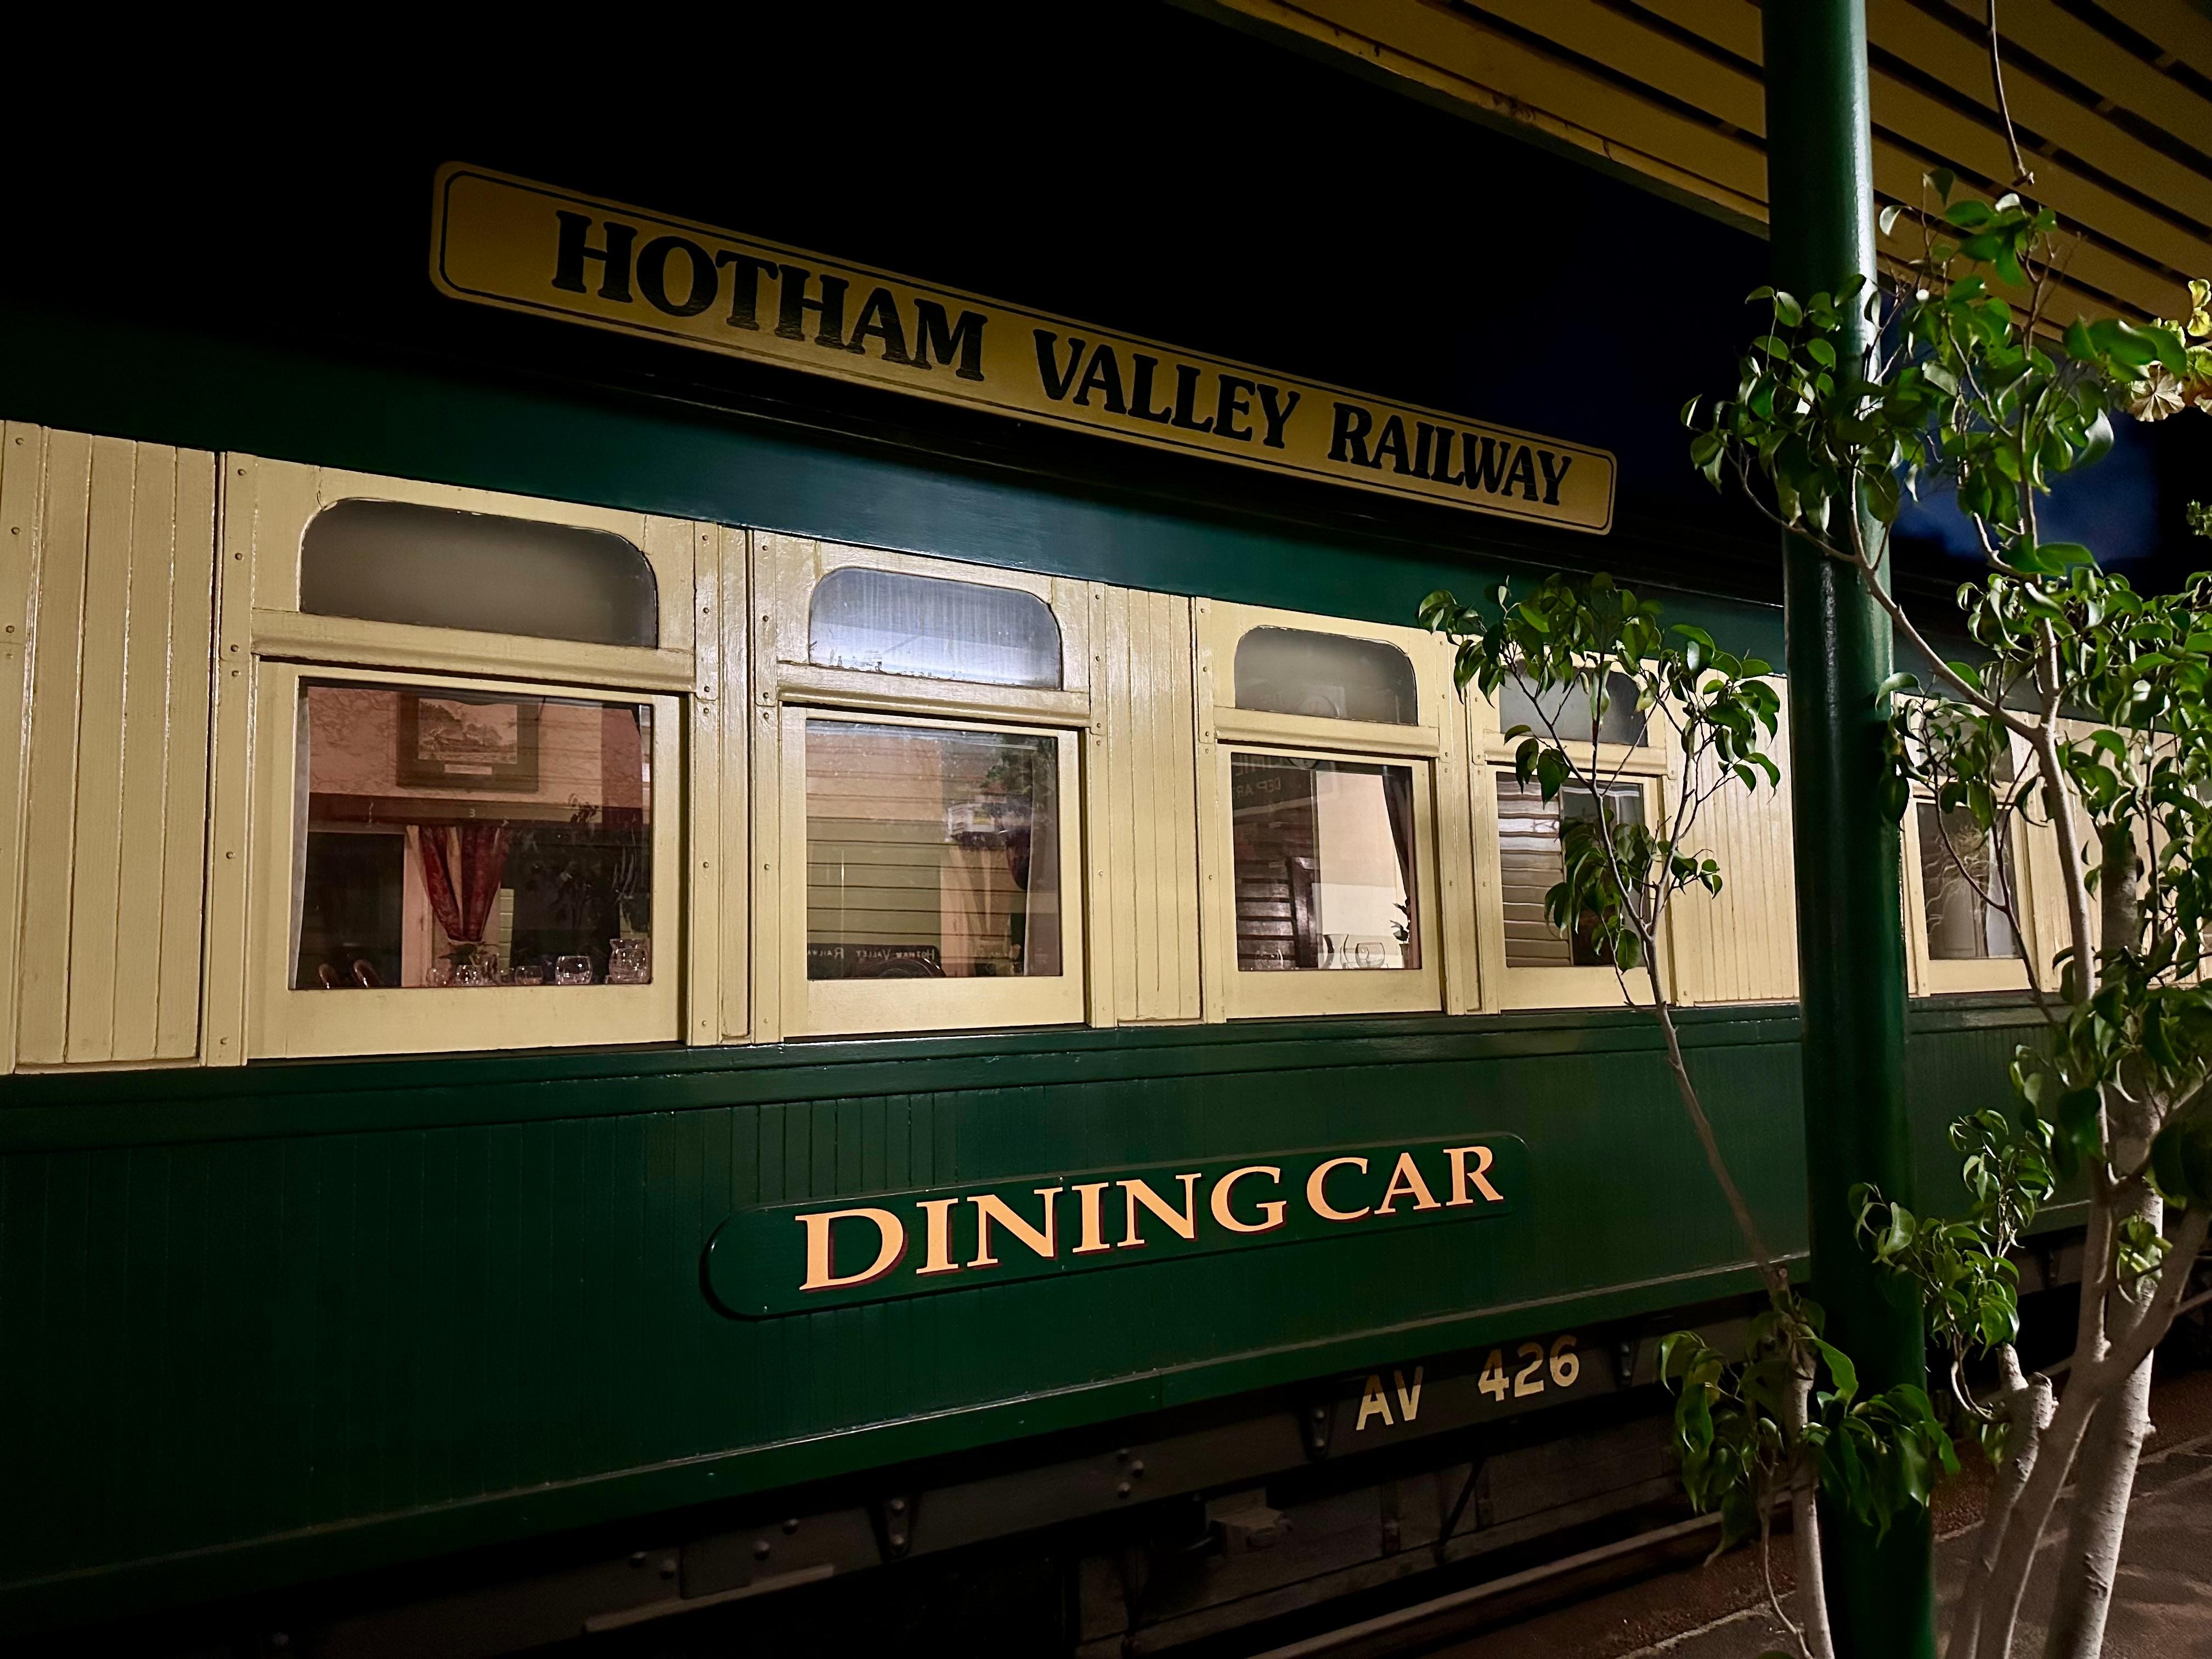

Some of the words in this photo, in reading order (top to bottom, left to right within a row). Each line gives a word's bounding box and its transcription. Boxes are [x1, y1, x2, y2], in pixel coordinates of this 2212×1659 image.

[551, 210, 988, 382] HOTHAM
[1032, 328, 1301, 449] VALLEY
[1328, 402, 1572, 506] RAILWAY
[795, 1166, 1287, 1292] DINING
[1306, 1146, 1504, 1222] CAR
[1356, 1366, 1423, 1430] AV
[1478, 1334, 1580, 1401] 426
